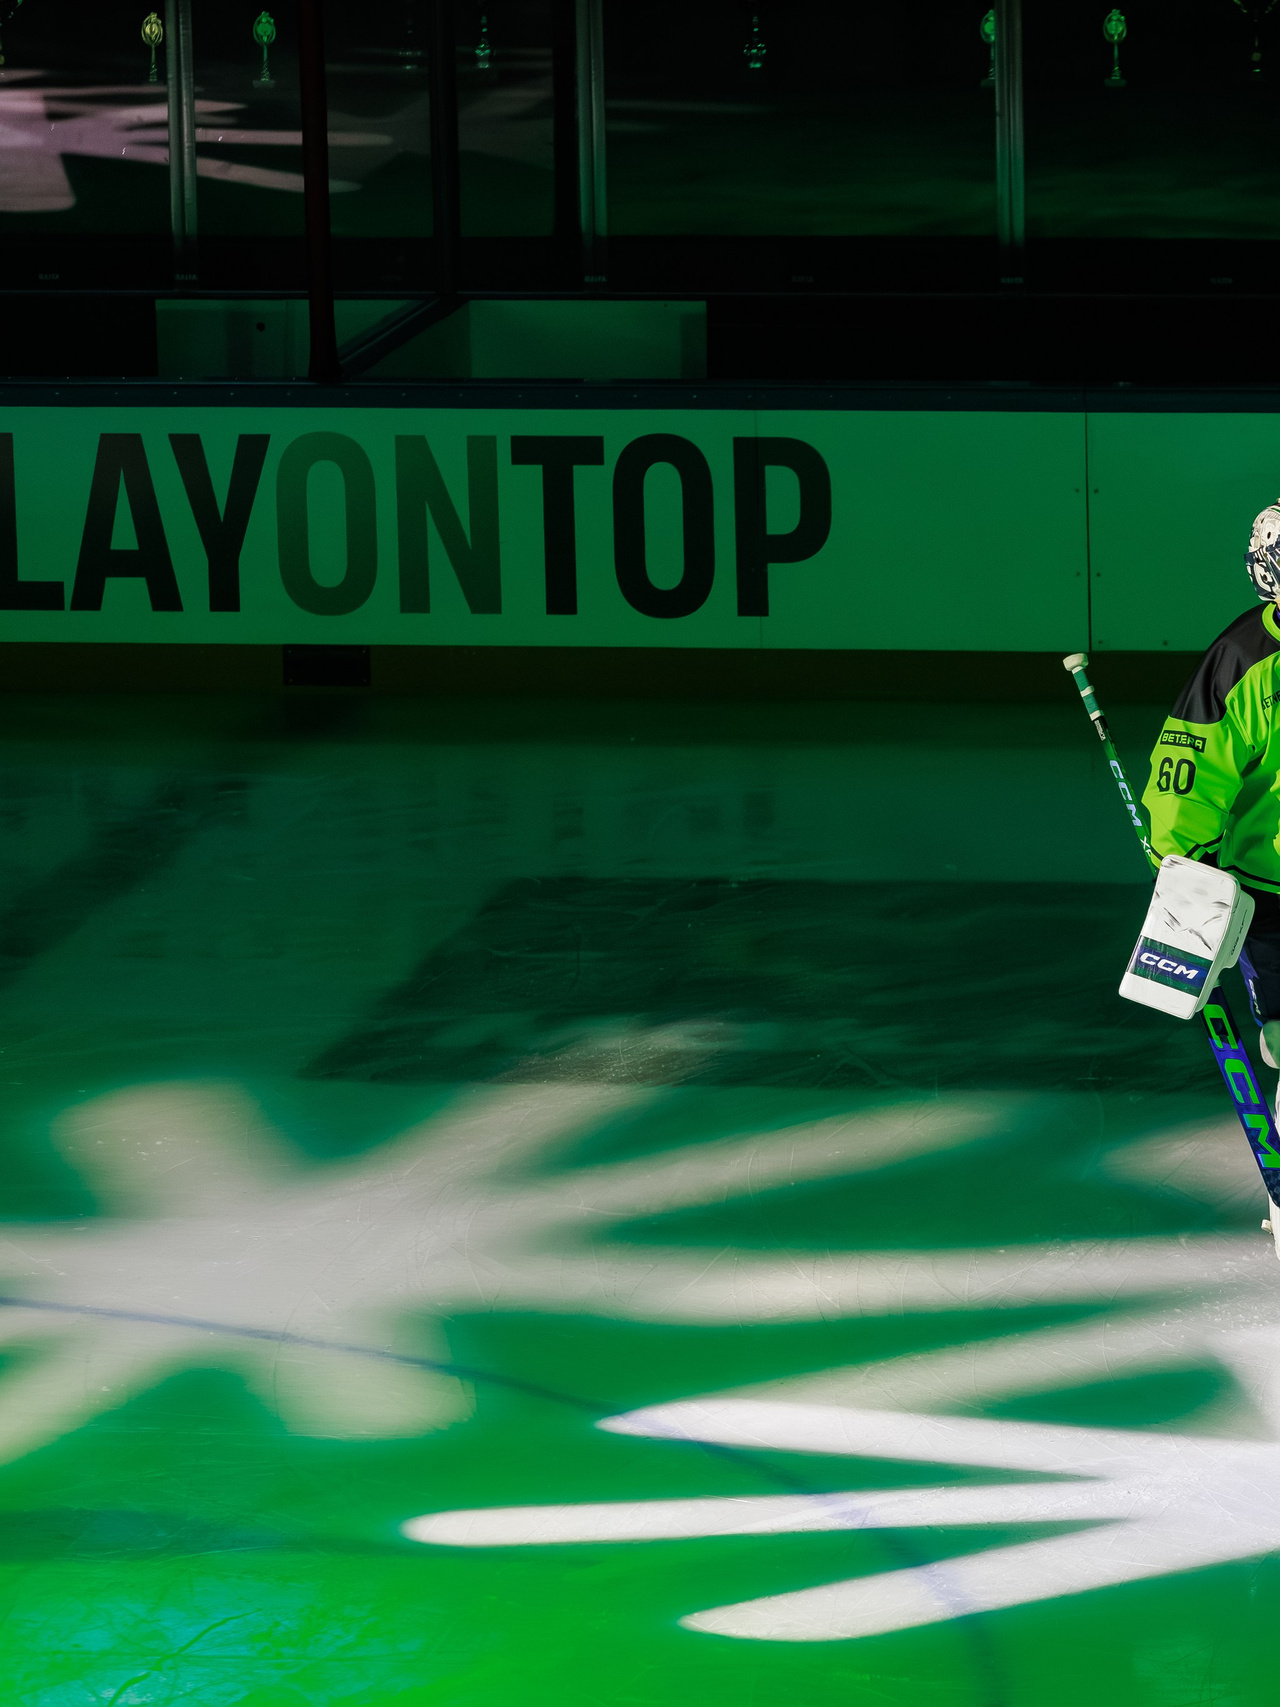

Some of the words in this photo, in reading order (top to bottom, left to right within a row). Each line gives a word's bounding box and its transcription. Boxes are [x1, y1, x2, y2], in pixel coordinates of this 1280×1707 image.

[1109, 760, 1143, 826] CCM
[1157, 757, 1196, 795] 60
[1140, 952, 1199, 980] CCM
